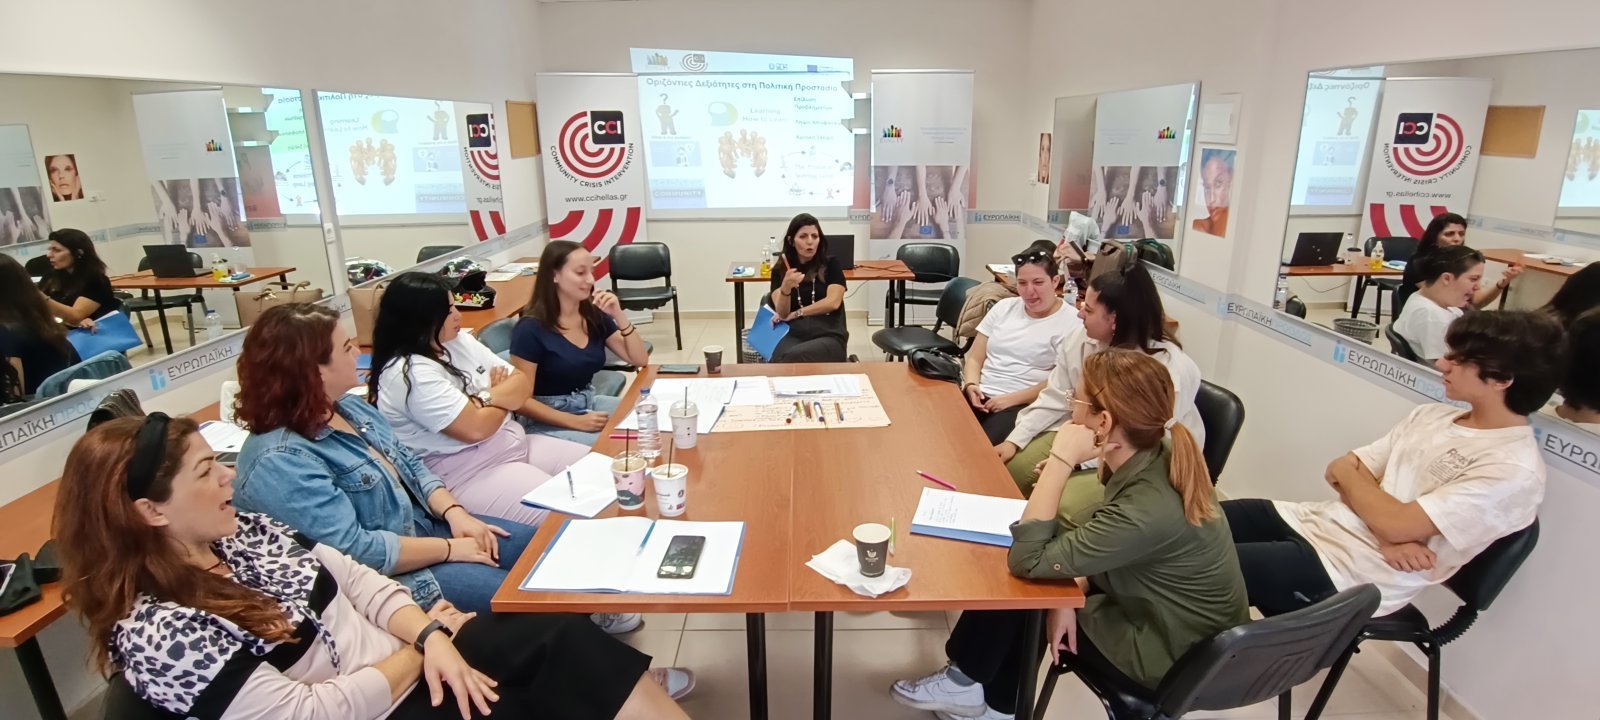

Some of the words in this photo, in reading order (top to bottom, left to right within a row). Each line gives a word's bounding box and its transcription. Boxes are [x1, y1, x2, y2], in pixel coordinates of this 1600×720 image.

[695, 80, 740, 90] Δεξιότητες
[742, 82, 757, 90] στη
[759, 82, 793, 91] Πολιτική
[593, 121, 622, 135] CCI
[551, 145, 579, 184] COMMUNITY
[579, 180, 603, 188] CRISIS
[604, 142, 634, 187] INTERVENTION
[565, 194, 628, 203] www.ccihellas.gr
[167, 345, 233, 379] ΕΥΡΩΠΑΪΚΗ
[1348, 350, 1417, 388] ΕΥΡΩΠΑΪΚΗ
[0, 414, 56, 449] ΠΑΪΚΗ
[1545, 433, 1600, 470] ΕΥΡΩ
